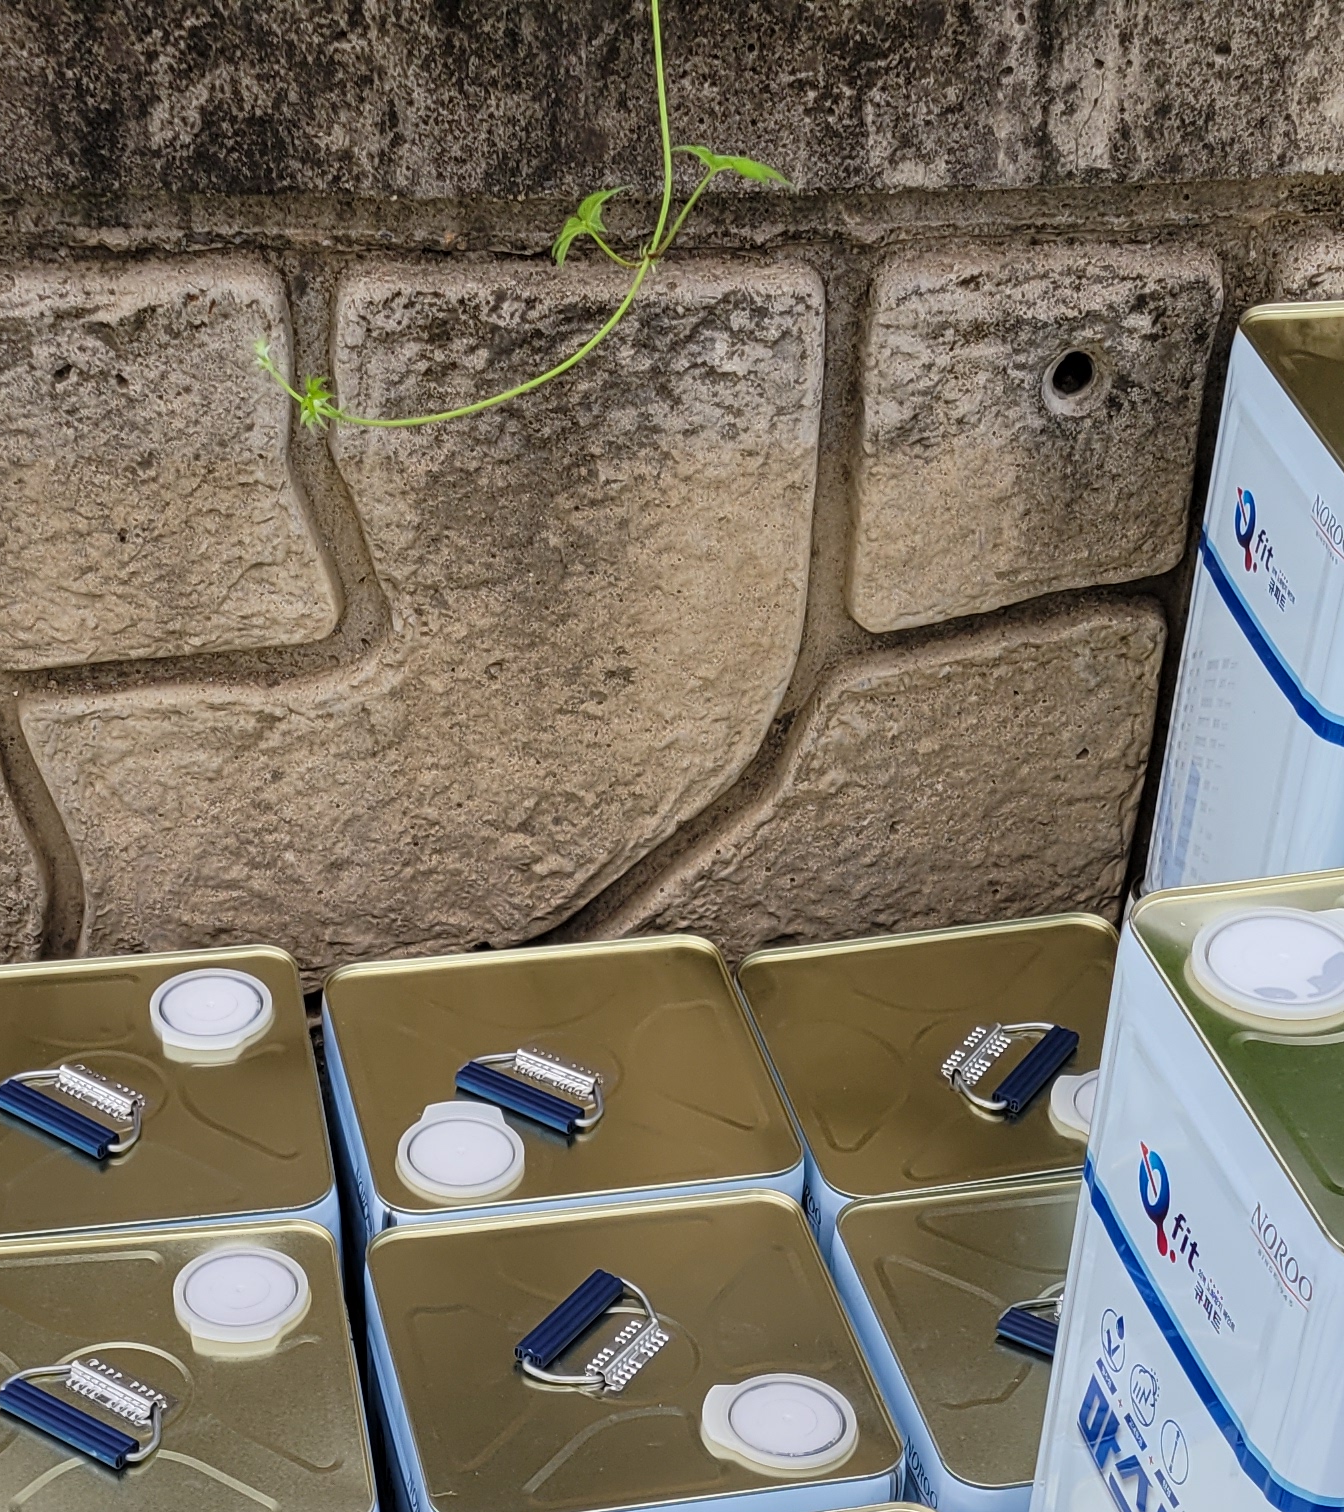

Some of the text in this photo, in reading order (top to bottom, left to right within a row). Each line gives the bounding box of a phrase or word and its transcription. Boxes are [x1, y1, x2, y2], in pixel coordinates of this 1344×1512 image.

[1172, 1213, 1200, 1273] fit
[1251, 1201, 1313, 1302] NOROO
[1194, 1281, 1221, 1334] 큐피트
[904, 1435, 938, 1509] NOROO
